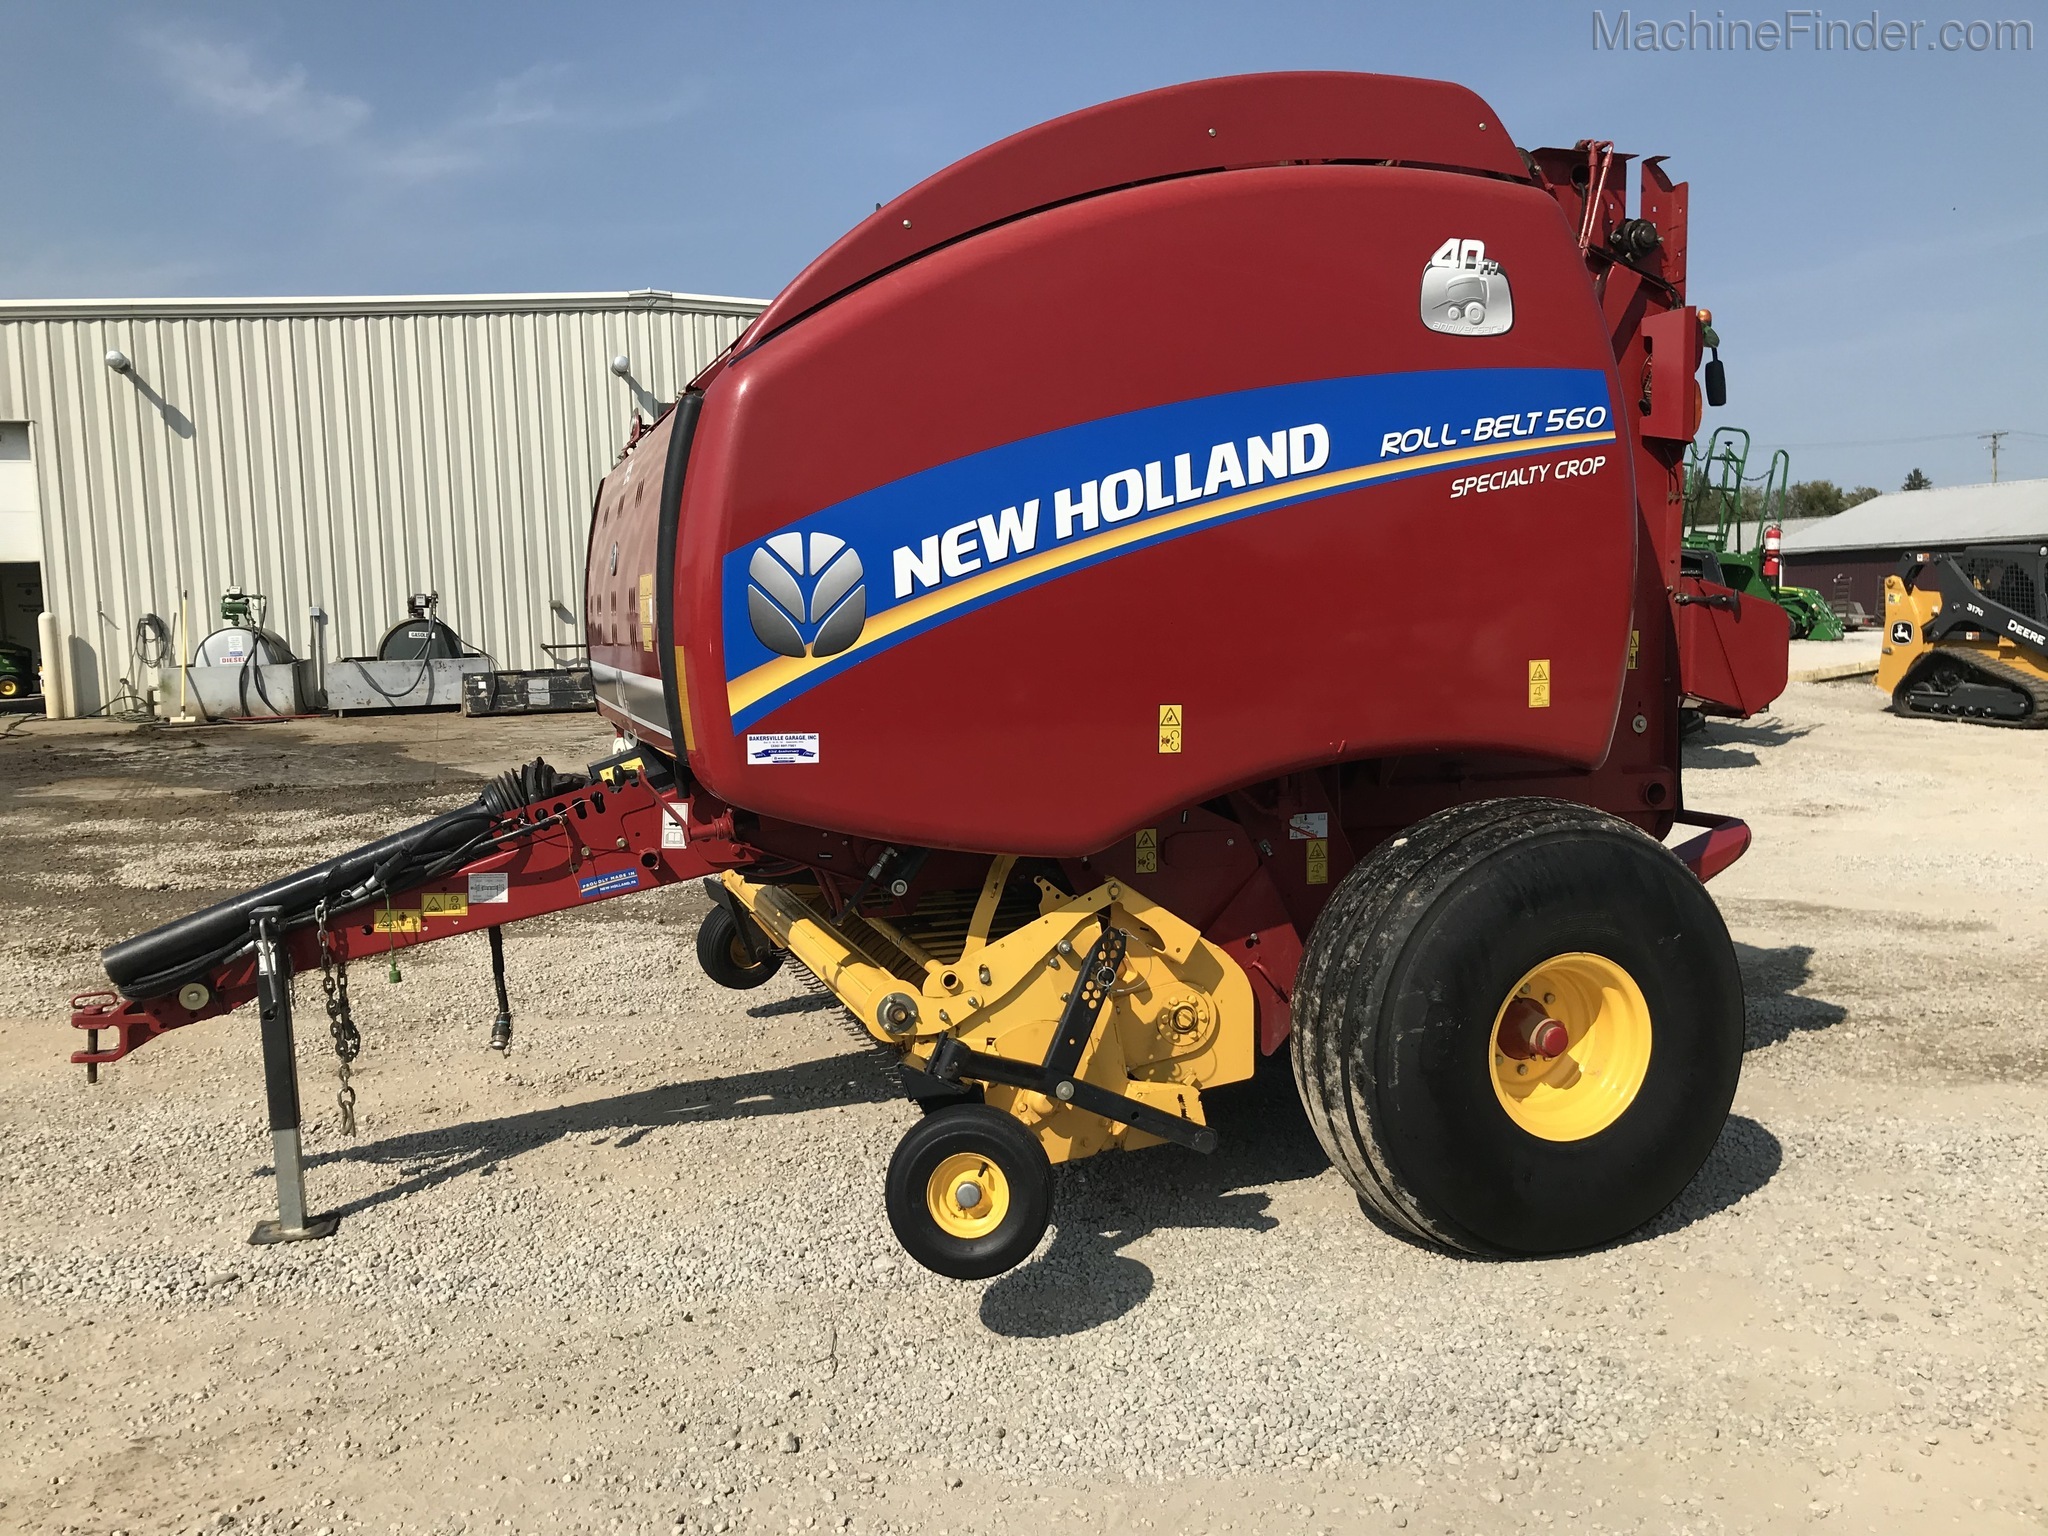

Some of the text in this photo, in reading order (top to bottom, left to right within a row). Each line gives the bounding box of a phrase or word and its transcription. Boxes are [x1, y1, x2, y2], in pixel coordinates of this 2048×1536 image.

[1544, 406, 1607, 433] 560
[1450, 456, 1606, 499] SPECIALTY CROP
[892, 422, 1330, 599] NEW HOLLAND
[1966, 602, 1984, 617] 317G
[2007, 618, 2046, 646] DEERE
[582, 877, 609, 888] PROUDLY
